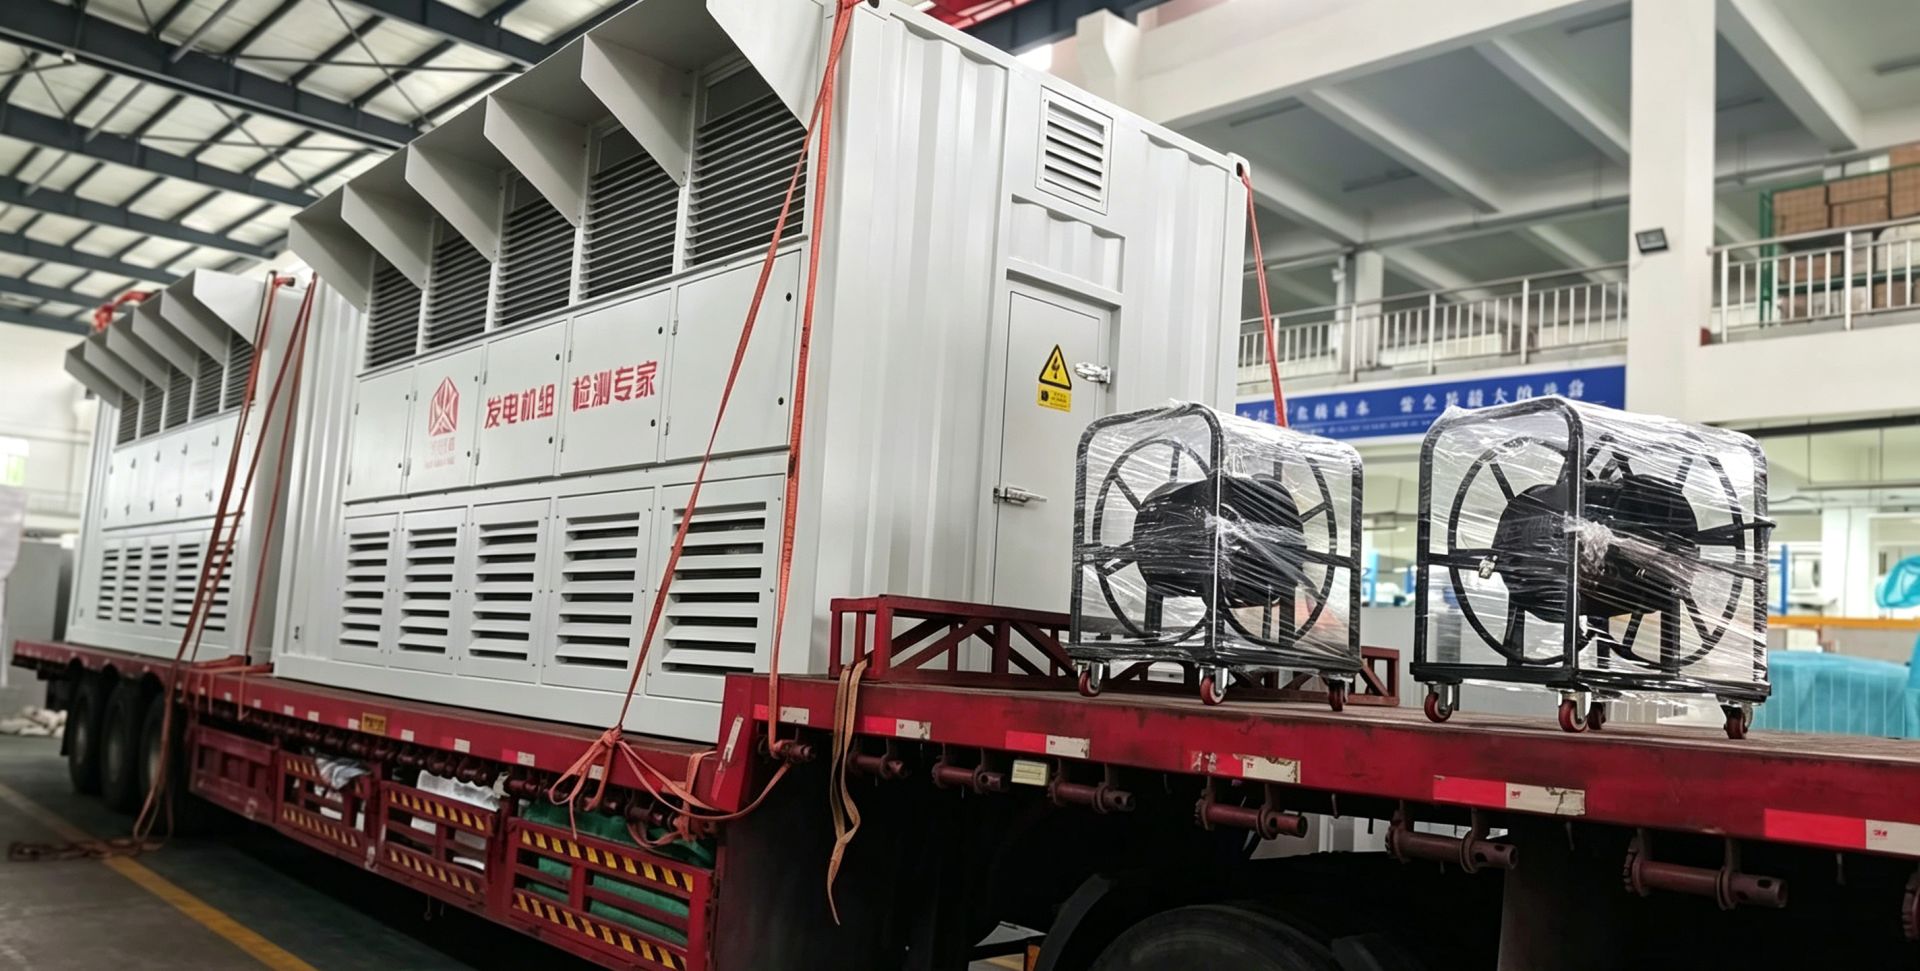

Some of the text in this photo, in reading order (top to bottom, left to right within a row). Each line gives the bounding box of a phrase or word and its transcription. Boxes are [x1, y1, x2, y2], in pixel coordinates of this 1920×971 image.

[484, 360, 658, 430] 发电机组 检测专家
